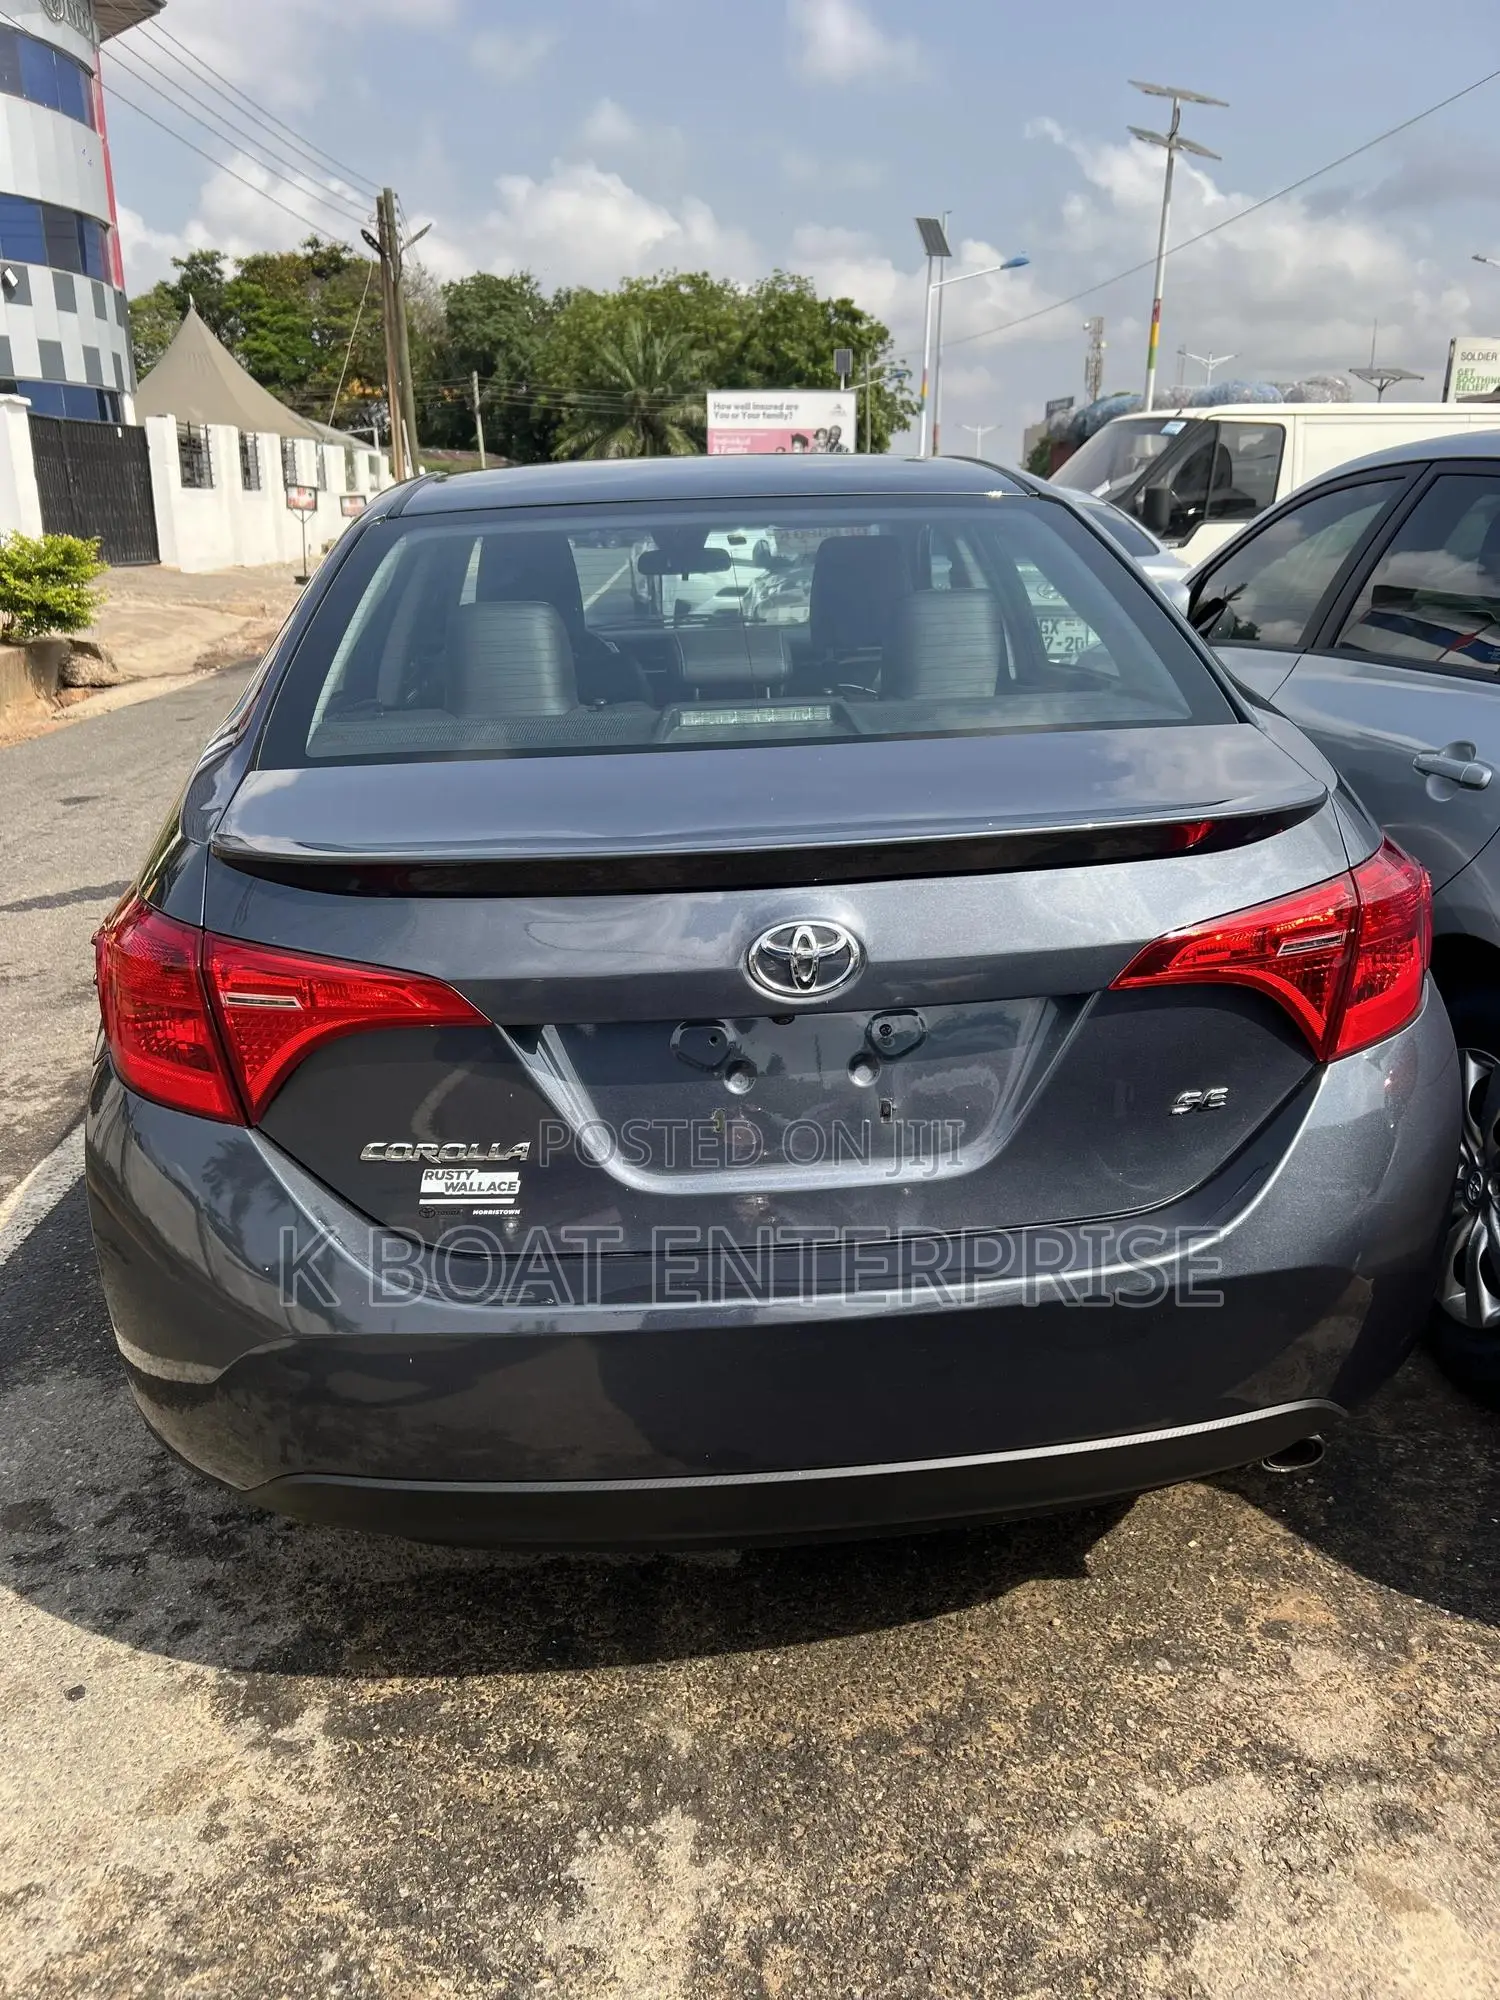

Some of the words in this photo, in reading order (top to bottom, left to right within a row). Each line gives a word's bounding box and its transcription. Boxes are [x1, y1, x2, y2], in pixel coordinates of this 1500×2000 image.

[1461, 352, 1497, 361] SOLDIER
[1457, 368, 1475, 376] GET
[713, 402, 732, 410] How
[734, 402, 750, 410] well
[752, 402, 784, 410] insured
[762, 412, 793, 421] family?
[1170, 1087, 1229, 1115] SE
[360, 1142, 532, 1163] COROLLA
[424, 1170, 475, 1180] RUSTY
[444, 1181, 518, 1192] WALLACE
